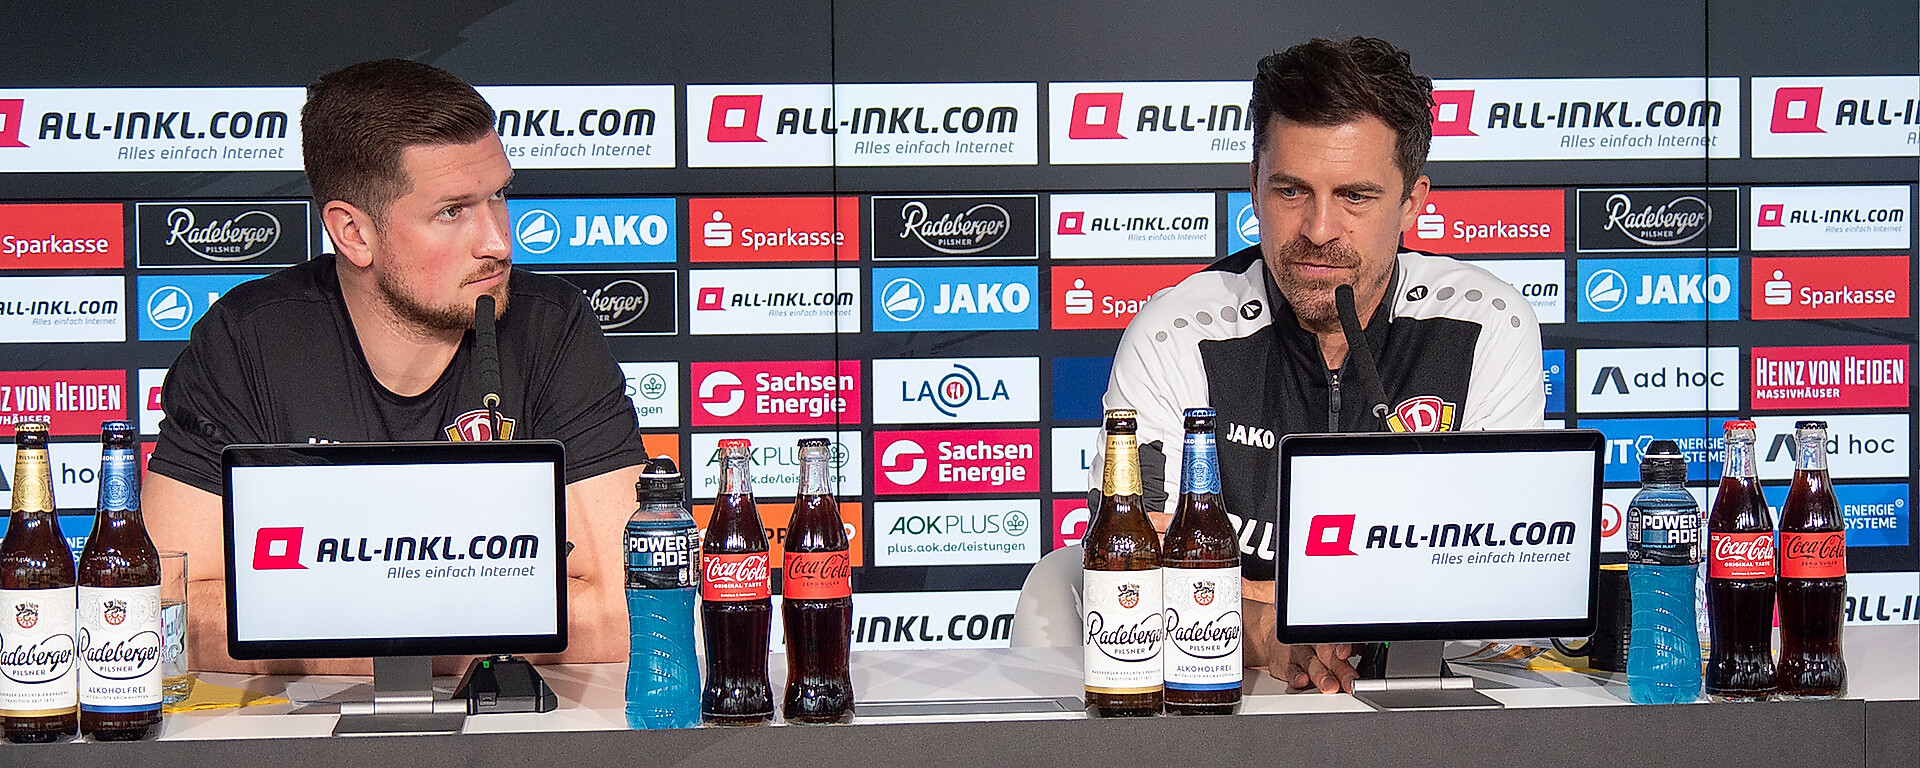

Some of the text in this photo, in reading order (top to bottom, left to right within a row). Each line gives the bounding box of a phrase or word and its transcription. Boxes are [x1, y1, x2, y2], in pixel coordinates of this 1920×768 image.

[39, 111, 289, 140] ALL-INKL.COM
[498, 108, 656, 136] NKL.COM
[776, 106, 1018, 135] ALL-INKL.COM
[1488, 101, 1721, 129] ALL-INKL.COM
[505, 143, 652, 157] les einfach Internet
[854, 140, 1014, 154] Alles einfach Internet
[1211, 138, 1247, 151] Alles
[1560, 135, 1596, 148] Alles
[1600, 134, 1653, 147] einfach
[118, 145, 285, 160] Alles einfach Internet
[899, 201, 1006, 247] Radeberger
[1090, 216, 1209, 231] ALL-INKL.COM
[1604, 193, 1706, 236] Radeberger
[1790, 209, 1904, 224] ALL-INKL.COM
[166, 207, 278, 249] Radeberger
[569, 215, 668, 246] JAKO
[741, 227, 845, 250] Sparkasse
[1127, 233, 1146, 241] Alles
[1147, 233, 1175, 241] einfach
[1453, 219, 1551, 241] Sparkasse
[1825, 225, 1843, 233] Alles
[1845, 225, 1872, 233] einfach
[2, 234, 109, 257] Sparkasse
[205, 245, 241, 253] PILSNER
[938, 238, 972, 246] PILSNER
[731, 292, 853, 307] ALL-INKL.COM
[934, 282, 1030, 314] JAKO
[1636, 274, 1730, 304] JAKO
[1800, 285, 1896, 309] Sparkasse
[32, 317, 117, 326] Alles einfach Internet
[768, 309, 787, 317] Alles
[789, 309, 818, 317] einfach
[755, 371, 854, 392] Sachsen
[1633, 366, 1725, 388] ad hoc
[1756, 356, 1904, 387] HEINZ VON HEIDEN
[15, 385, 51, 412] VON
[55, 381, 121, 411] HEIDEN
[902, 363, 1010, 418] LAOLA
[1757, 387, 1840, 399] MASSIVHÄUSER
[756, 393, 847, 418] Energie
[1226, 422, 1275, 449] JAKO
[1849, 434, 1895, 454] hoc
[763, 446, 800, 466] PLU
[938, 440, 1033, 460] Sachsen
[62, 463, 101, 484] ho
[938, 461, 1026, 486] Energie
[1844, 503, 1895, 516] ENERGIE
[888, 514, 1000, 535] AOK PLUS
[1642, 514, 1697, 529] POWER
[1843, 517, 1897, 529] SYSTEME
[629, 535, 687, 552] POWER
[1366, 520, 1576, 549] ALL-INKL.COM
[1667, 529, 1697, 543] ADE
[316, 534, 539, 562] ALL-INKL.COM
[887, 541, 1026, 556] plus.aok.de/leistungen
[1715, 535, 1774, 561] Coca-Cola
[1786, 534, 1844, 559] Coca-Cola
[652, 550, 688, 567] ADE
[706, 555, 768, 582] Coca-Cola
[789, 553, 848, 580] Coca-Cola
[1431, 551, 1571, 565] Alles einfach Internet
[387, 565, 536, 580] Alles einfach Internet
[0, 640, 72, 672] adeberger
[79, 627, 158, 669] Radeberger
[1177, 664, 1232, 673] ALKOHOLFREI
[88, 686, 146, 694] ALKOHOLFREI
